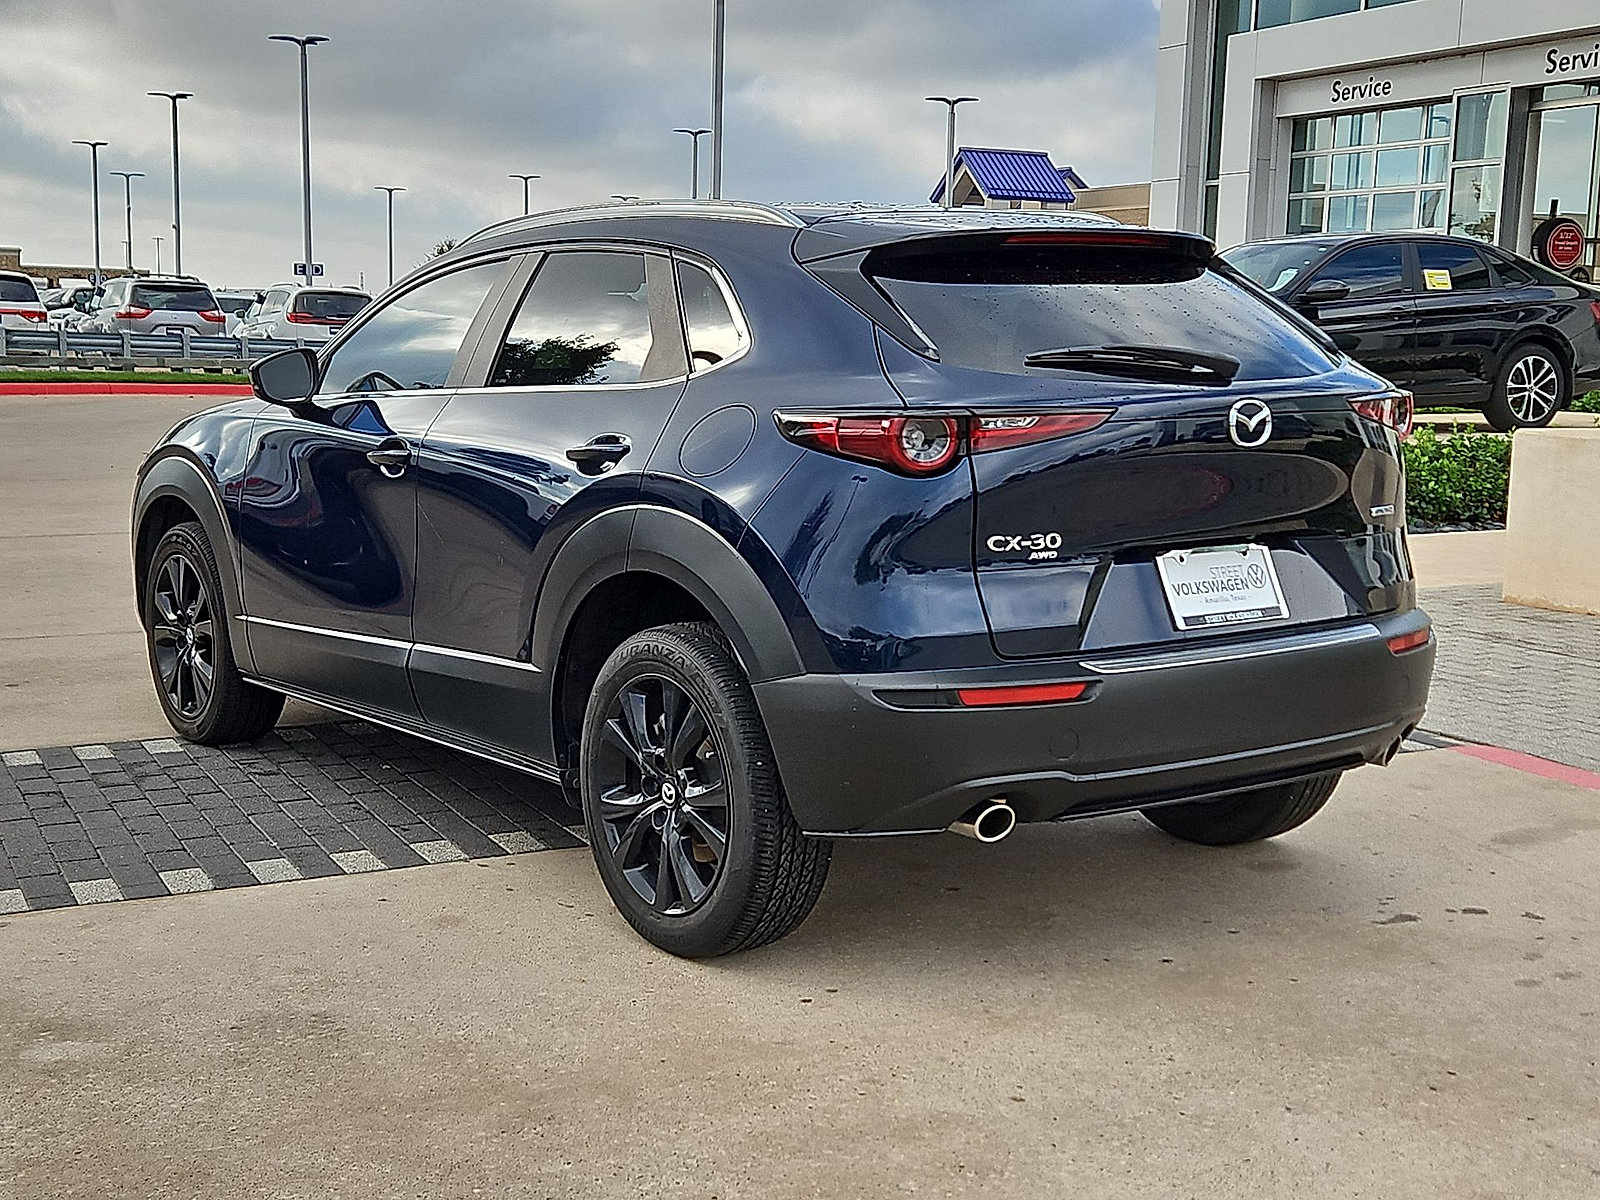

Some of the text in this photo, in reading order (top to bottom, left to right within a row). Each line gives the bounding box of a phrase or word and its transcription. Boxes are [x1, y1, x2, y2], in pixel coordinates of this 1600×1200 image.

[1544, 43, 1600, 74] Servi
[1331, 76, 1392, 103] Service
[296, 264, 304, 275] E
[312, 264, 322, 275] D
[986, 532, 1062, 552] CX-30
[1028, 550, 1058, 560] AWD
[1209, 565, 1244, 579] STREET
[1172, 577, 1250, 597] VOLKSWAGEN
